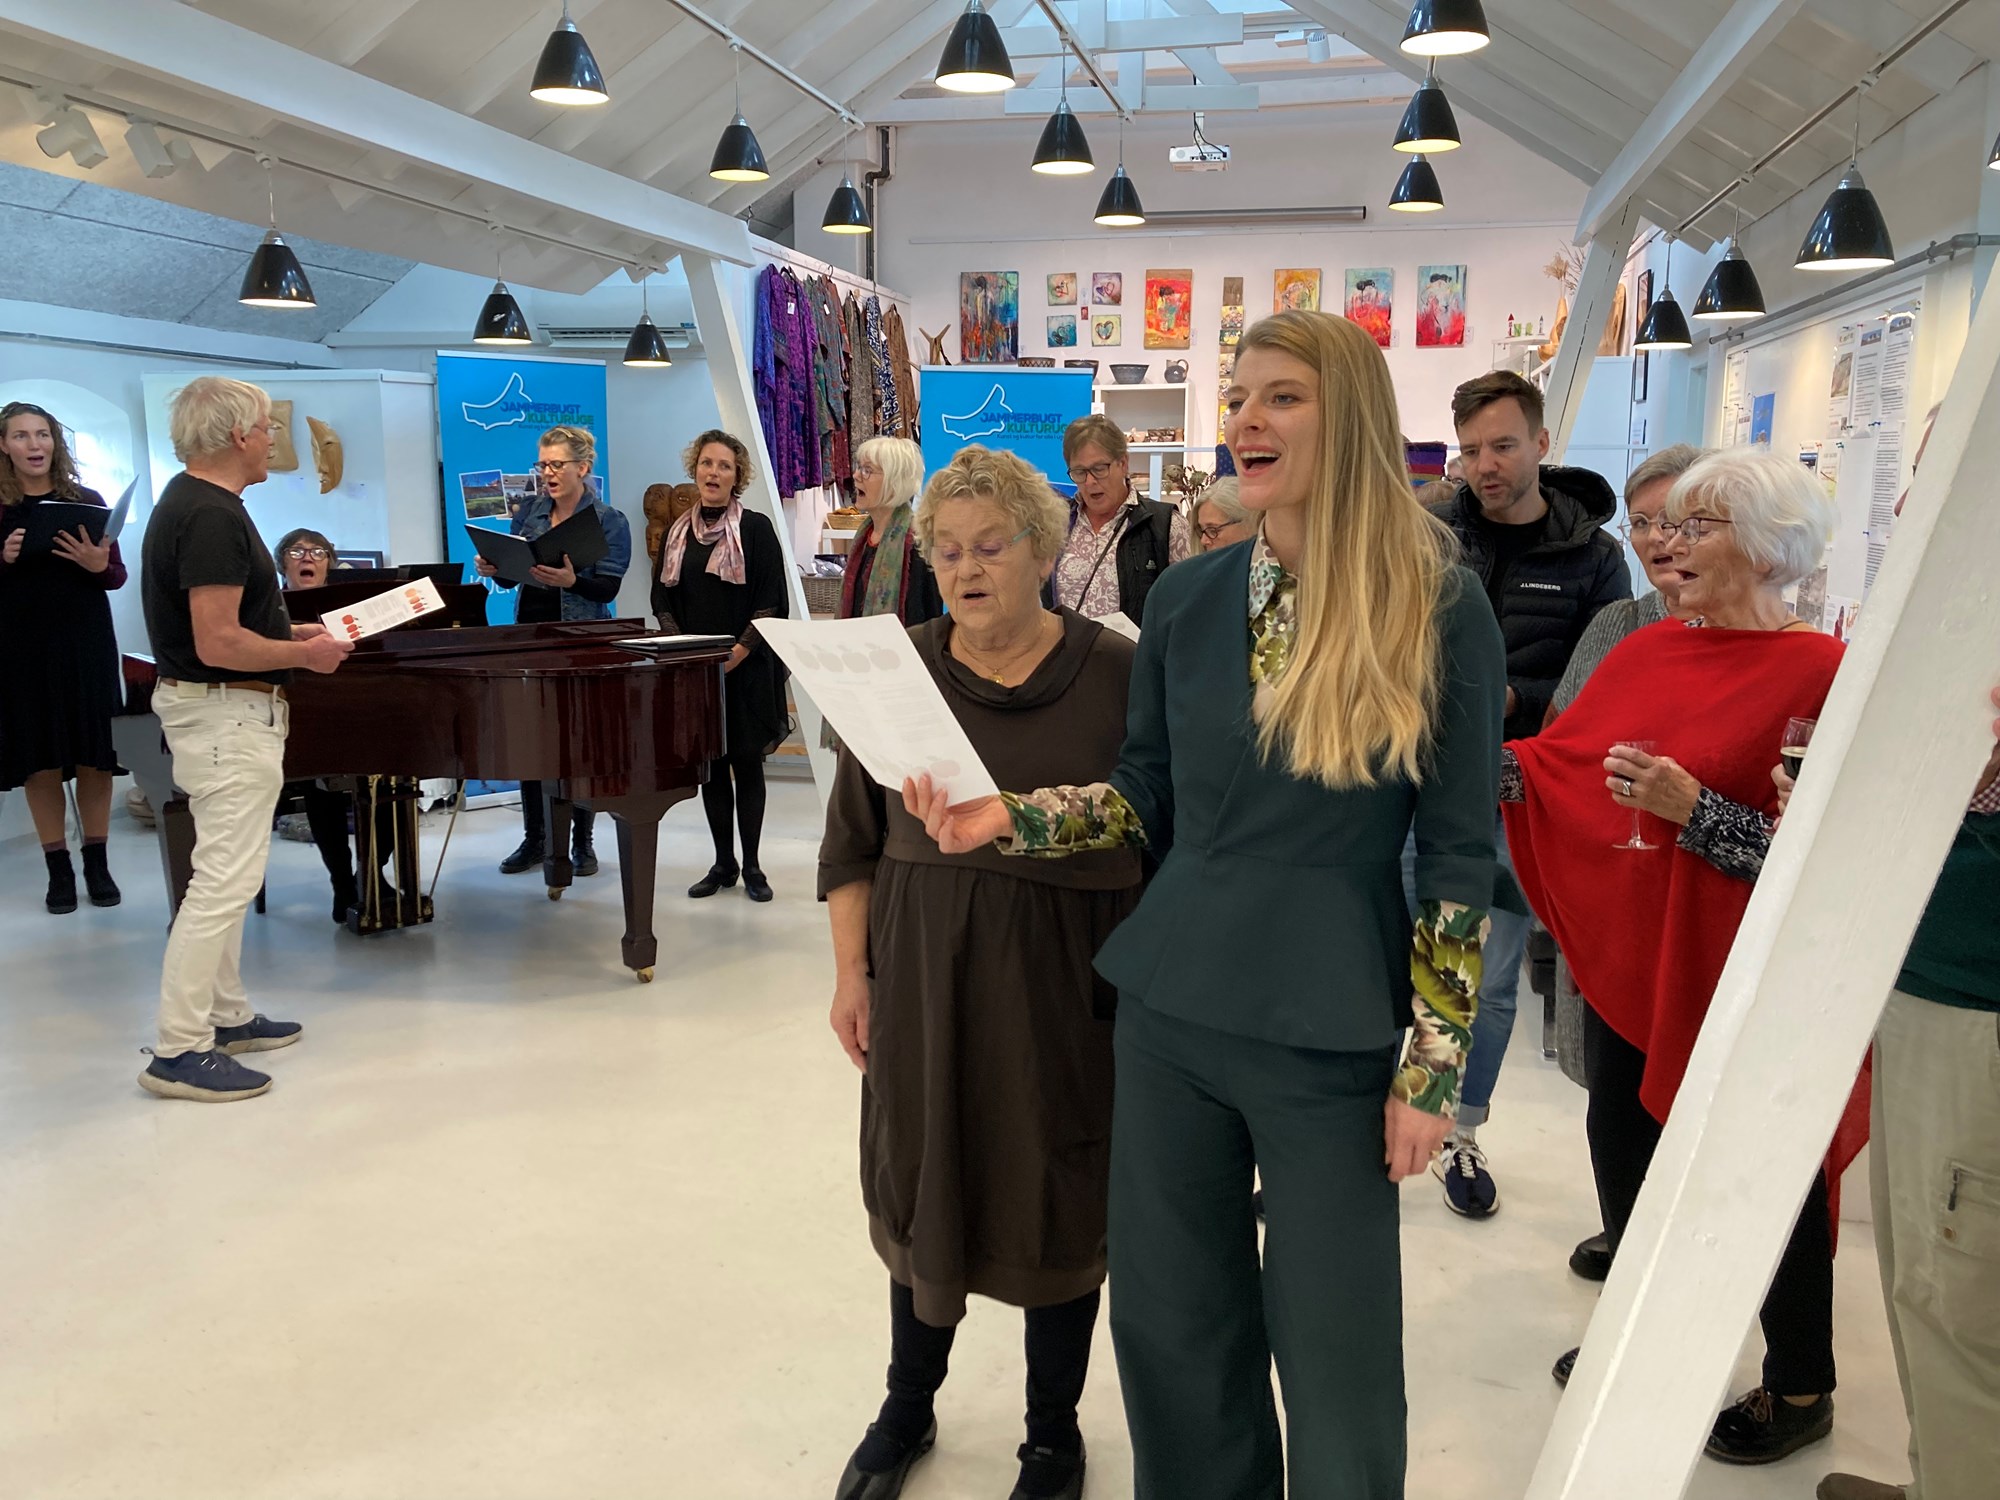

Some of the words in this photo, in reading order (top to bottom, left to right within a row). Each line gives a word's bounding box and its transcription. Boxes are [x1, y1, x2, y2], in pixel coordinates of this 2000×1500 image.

[500, 401, 582, 415] JAMMERBUGT
[526, 412, 595, 425] KULTURUGE
[980, 412, 1063, 424] JAMMERBUGT
[1006, 422, 1068, 434] KULTURUG
[1520, 582, 1561, 591] J.LINDEBERG
